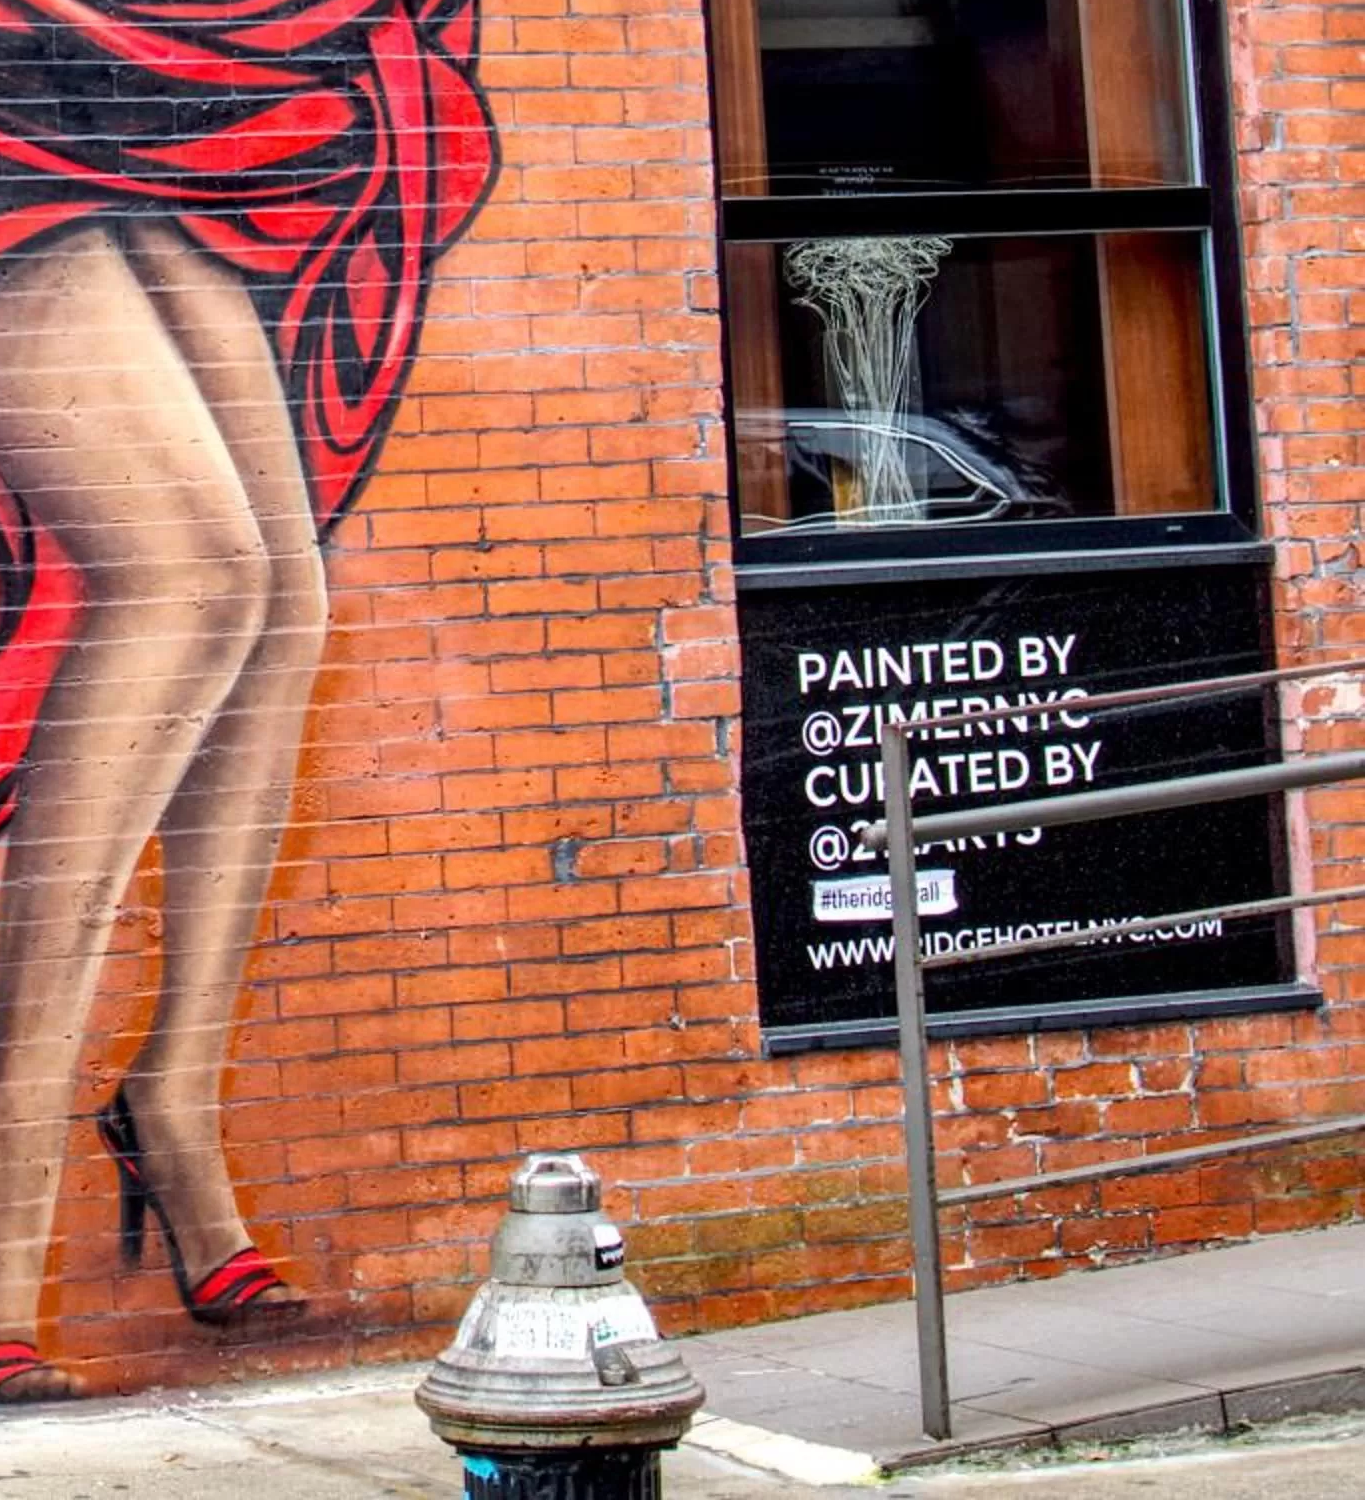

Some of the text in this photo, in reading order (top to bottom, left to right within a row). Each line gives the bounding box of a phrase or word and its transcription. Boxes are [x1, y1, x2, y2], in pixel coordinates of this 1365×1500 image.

[797, 634, 1076, 693] PAINTED BY
[802, 688, 1090, 756] @ZIMERNYC
[1044, 741, 1102, 786] BY
[821, 882, 940, 911] #theridgall
